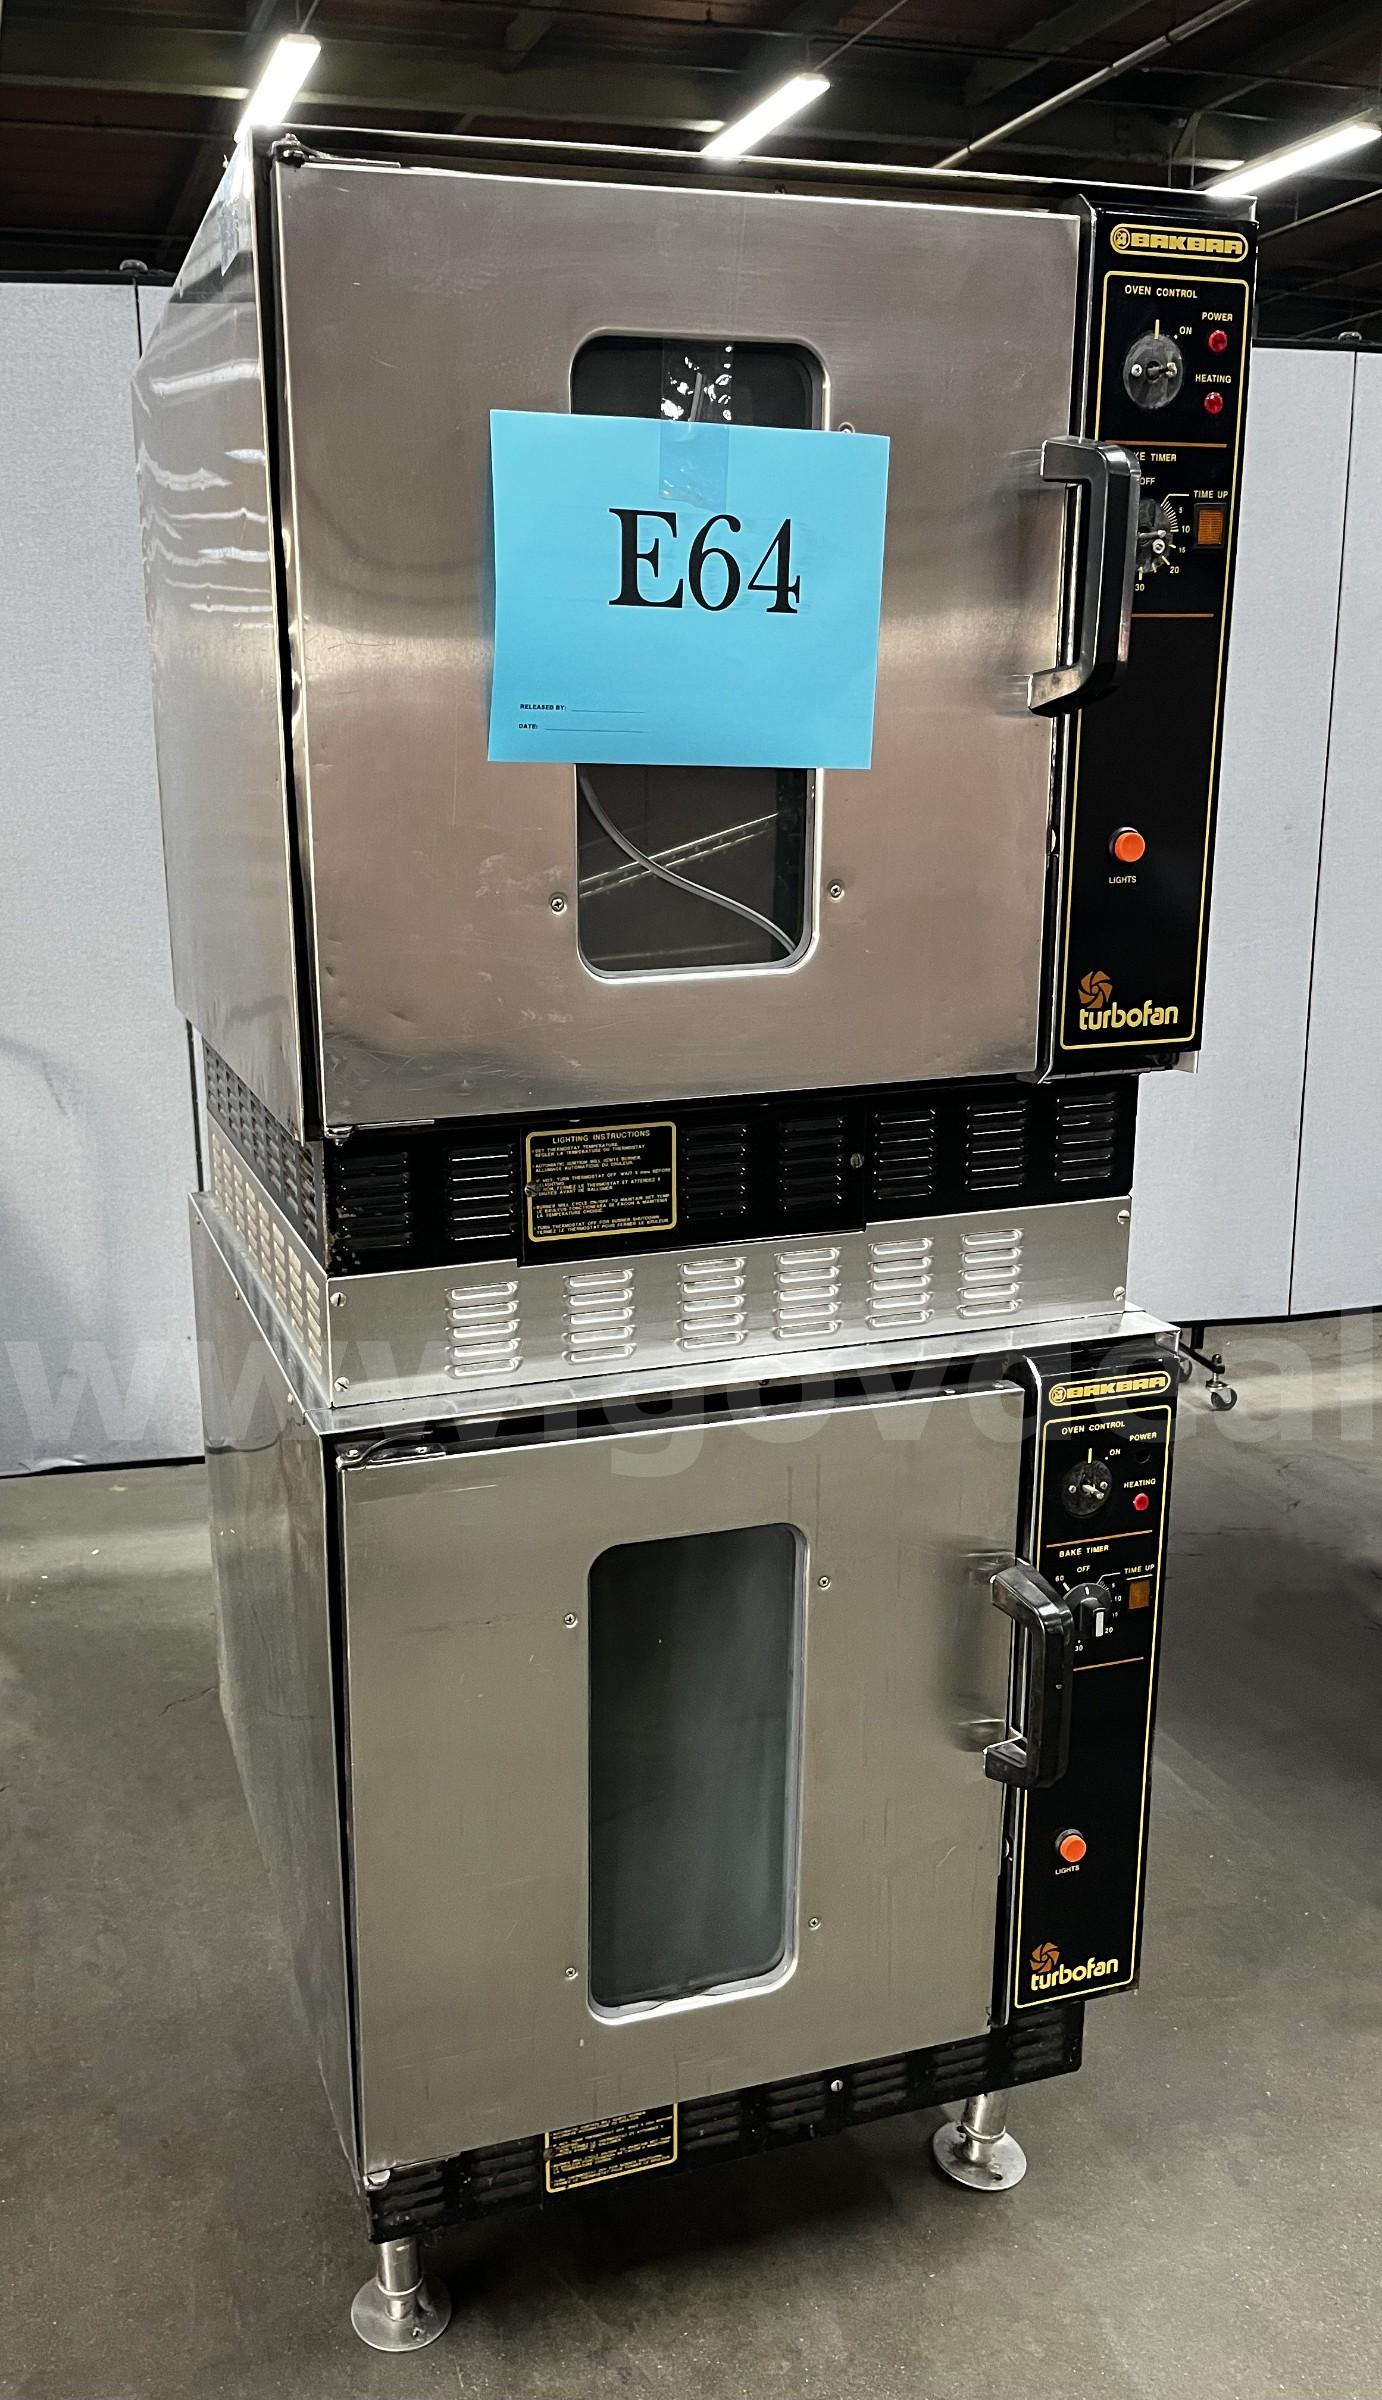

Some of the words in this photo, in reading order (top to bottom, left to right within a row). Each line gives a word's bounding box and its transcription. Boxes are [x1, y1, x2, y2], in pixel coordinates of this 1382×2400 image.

[1131, 232, 1243, 255] BAKBAR
[1124, 284, 1151, 295] OVEN
[1156, 287, 1198, 299] CONTROL
[1201, 311, 1233, 322] POWER
[1179, 326, 1192, 335] ON
[1195, 373, 1232, 383] HEATING
[1151, 453, 1177, 462] TIMER
[1139, 477, 1156, 485] OFF
[1193, 490, 1214, 499] TIME
[1217, 491, 1229, 499] UP
[1181, 525, 1190, 533] 10
[608, 507, 801, 614] E64
[1169, 566, 1180, 574] 20
[1135, 583, 1145, 591] 30
[519, 703, 554, 711] RELEASED
[1108, 875, 1137, 884] LIGHTS
[1079, 1000, 1179, 1030] turbofan
[552, 1134, 589, 1145] LIGHTING
[592, 1130, 651, 1140] INSTRUCTIONS
[1066, 1376, 1166, 1399] BAKBAR
[1061, 1425, 1085, 1435] OVEN
[1088, 1420, 1125, 1431] CONTROL
[1129, 1431, 1157, 1441] POWER
[1109, 1448, 1121, 1456] ON
[1123, 1478, 1156, 1489] HEATING
[1058, 1547, 1082, 1558] BAKE
[1086, 1544, 1109, 1554] TIMER
[1076, 1565, 1091, 1573] OFF
[1123, 1565, 1142, 1574] TIME
[1144, 1563, 1155, 1572] UP
[1104, 1626, 1114, 1634] 20
[1074, 1644, 1084, 1652] 30
[1055, 1864, 1080, 1875] LIGHTS
[1031, 1957, 1118, 1991] turbofan
